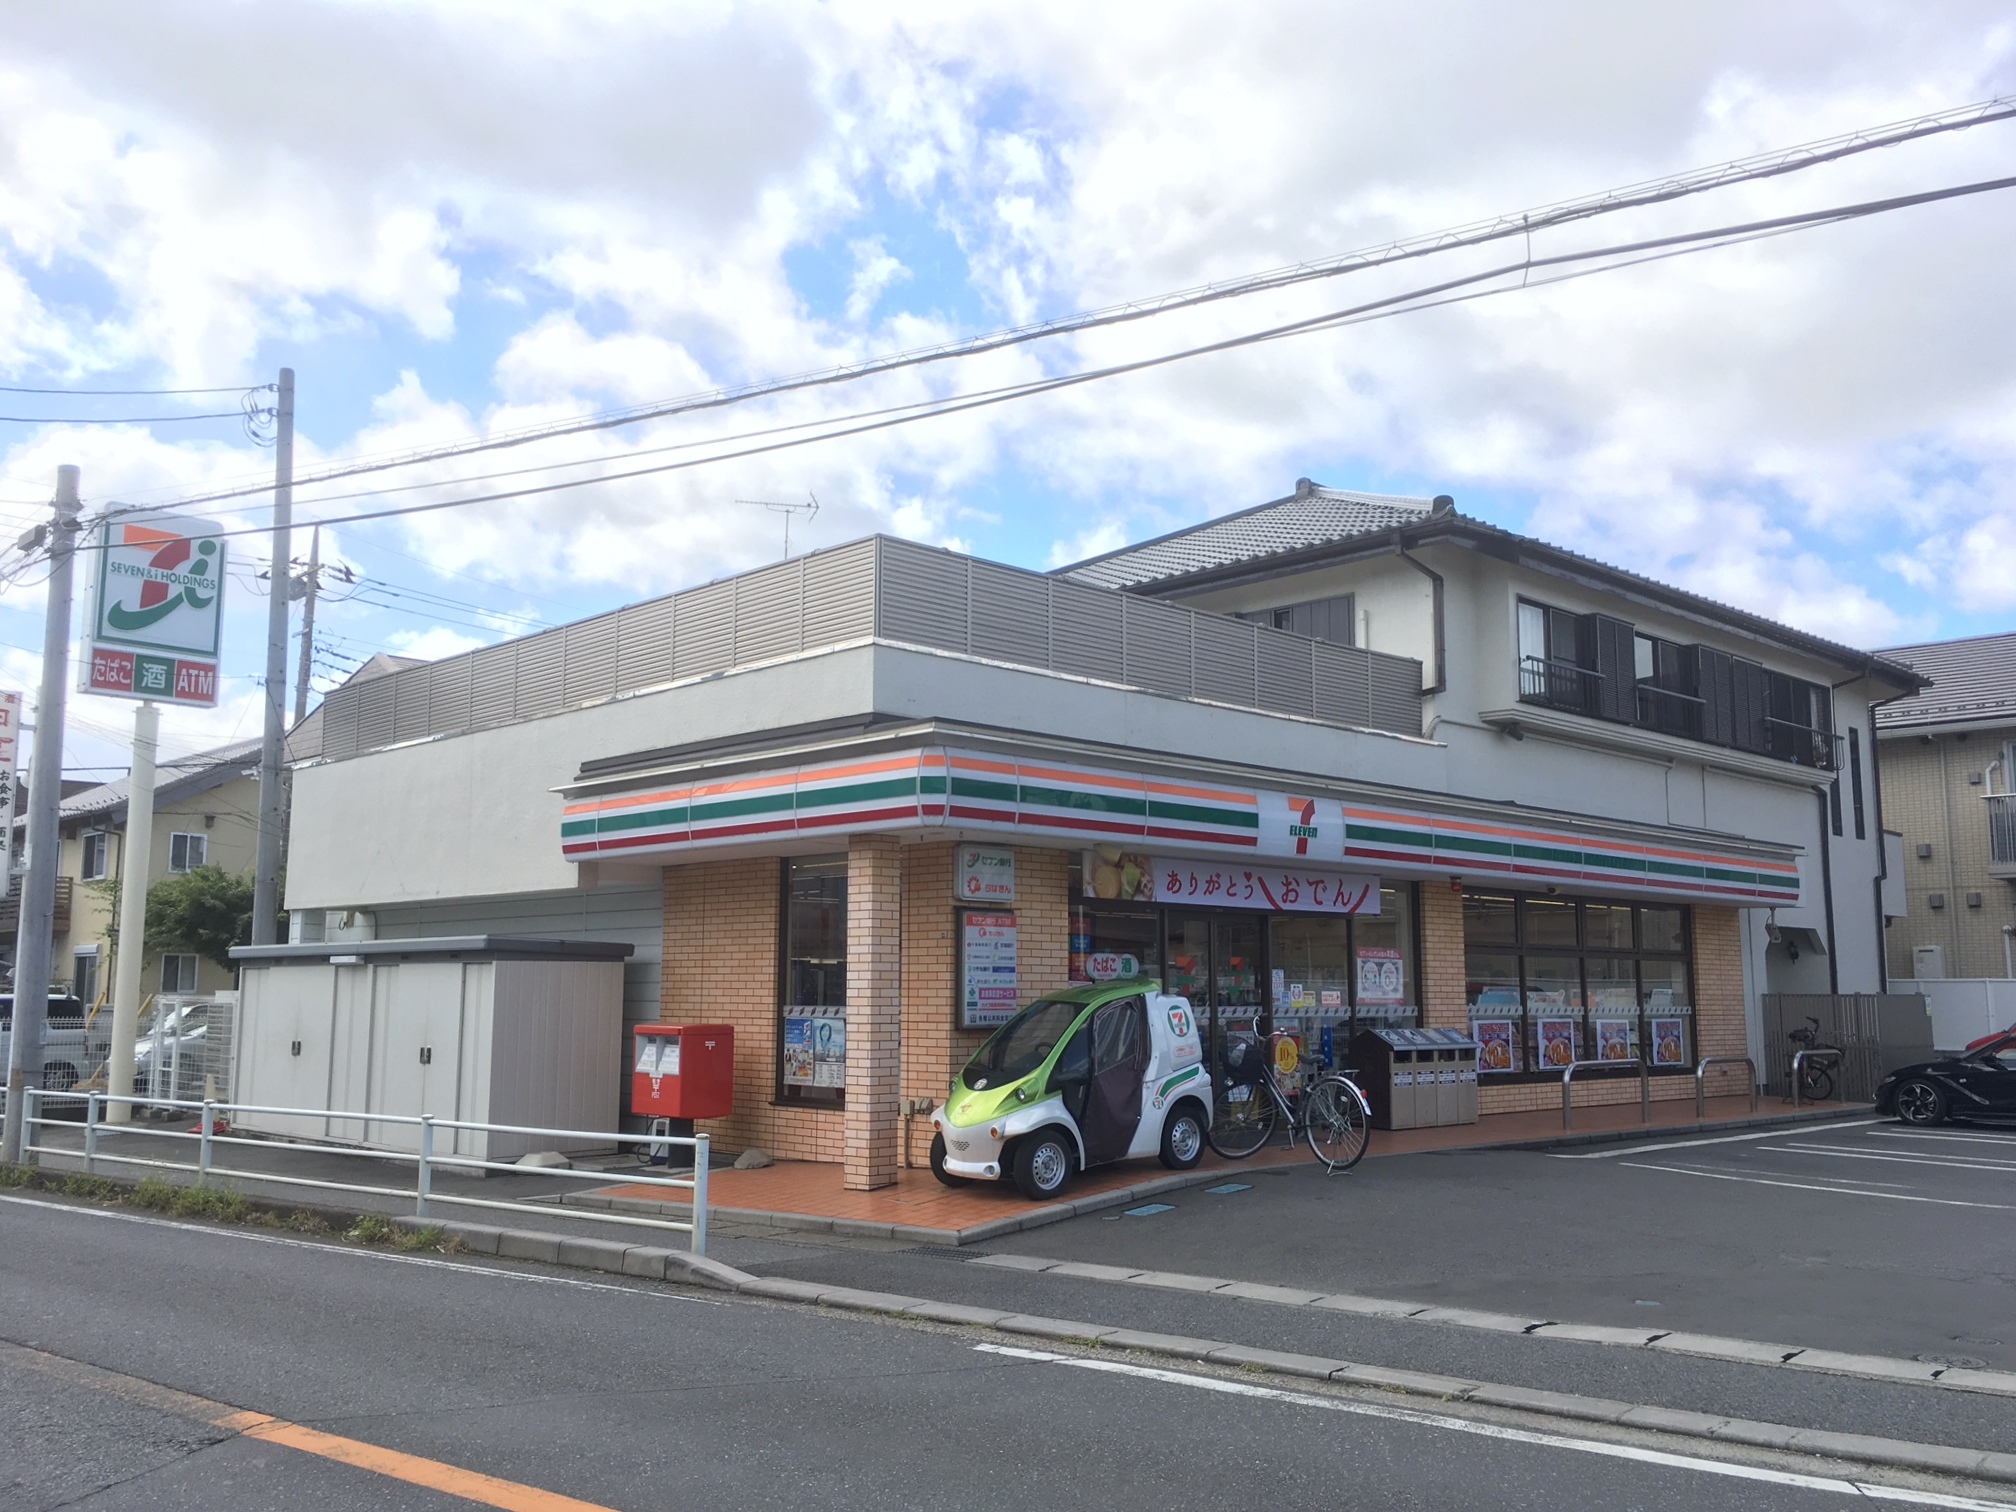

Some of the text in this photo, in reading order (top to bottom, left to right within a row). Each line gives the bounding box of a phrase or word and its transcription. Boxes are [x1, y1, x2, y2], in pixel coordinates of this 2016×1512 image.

[161, 572, 216, 590] HOLDINGS
[93, 657, 131, 684] たばこ
[141, 663, 167, 689] 酒
[177, 668, 214, 695] ATM
[1166, 870, 1352, 907] ありがとう おでん
[1092, 957, 1117, 973] たばこ
[1121, 957, 1132, 973] 酒
